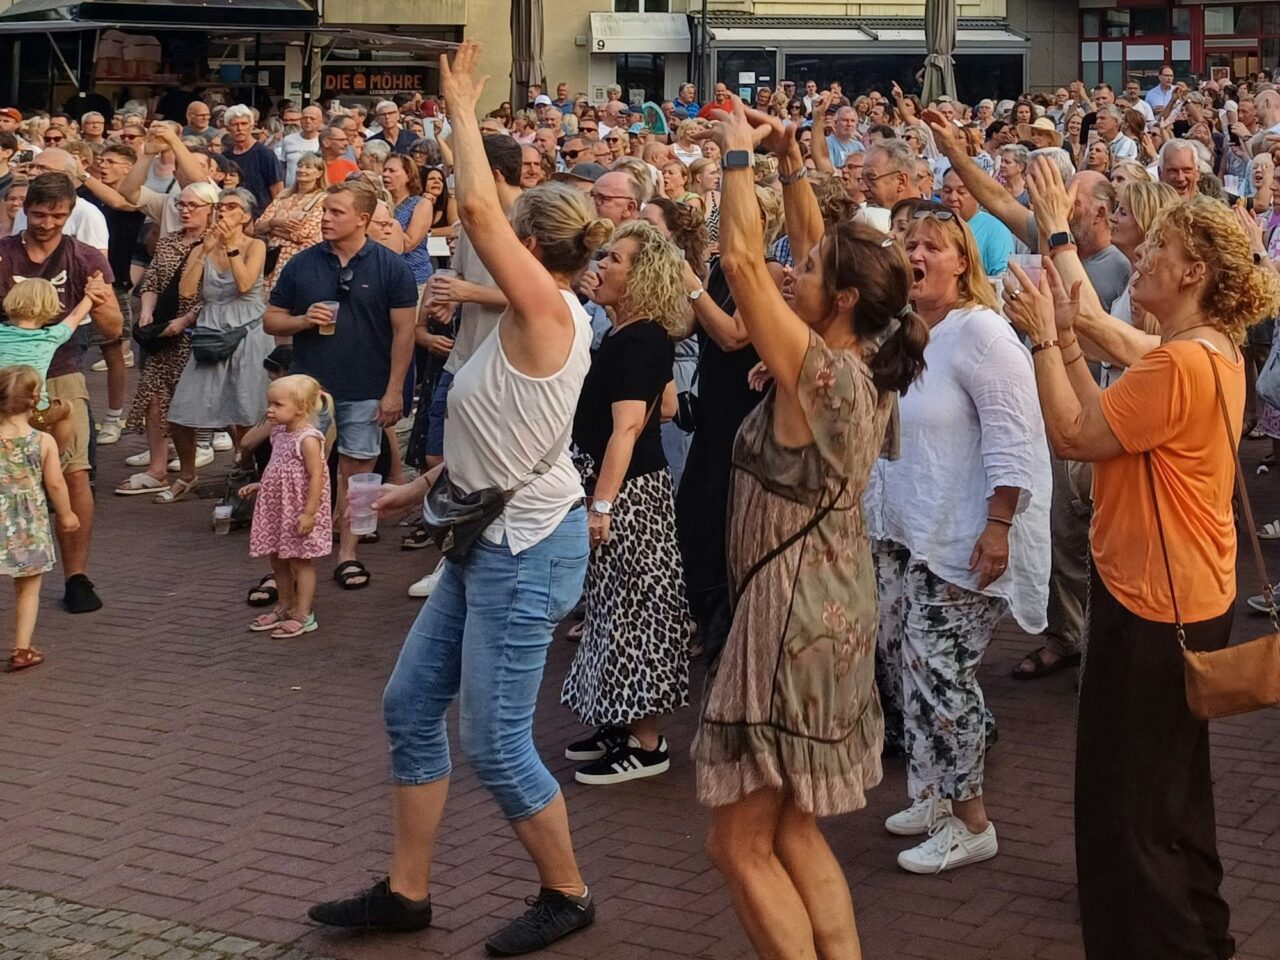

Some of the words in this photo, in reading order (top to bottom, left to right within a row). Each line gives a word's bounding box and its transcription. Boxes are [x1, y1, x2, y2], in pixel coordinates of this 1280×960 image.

[597, 40, 605, 50] 9
[325, 74, 350, 90] DIE
[369, 71, 422, 90] MÖHRE
